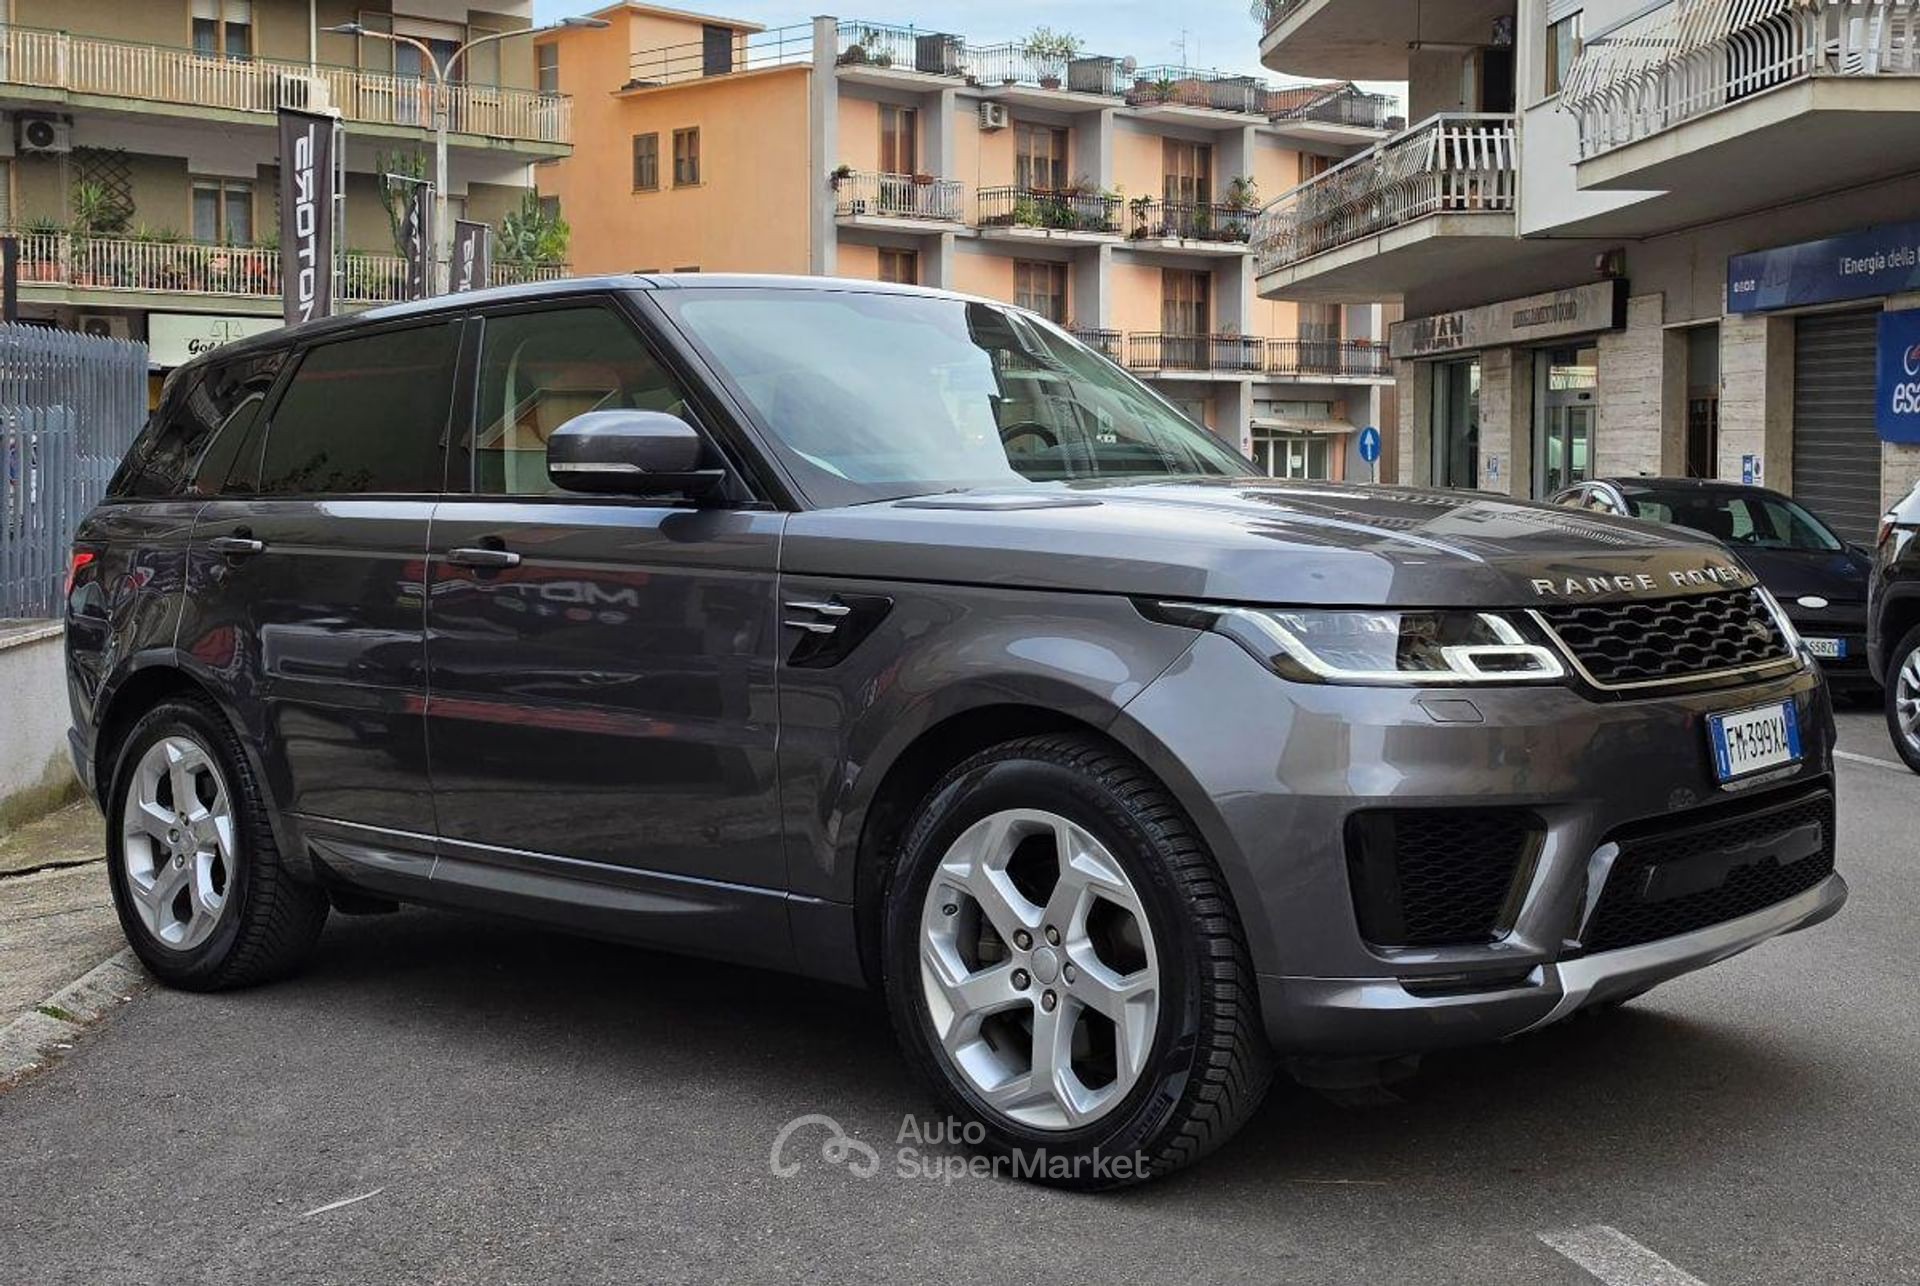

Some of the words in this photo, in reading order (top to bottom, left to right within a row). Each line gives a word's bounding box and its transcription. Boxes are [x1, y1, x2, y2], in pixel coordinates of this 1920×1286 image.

[1888, 246, 1915, 267] della
[1531, 573, 1657, 596] RANGE
[1668, 565, 1744, 587] ROVER
